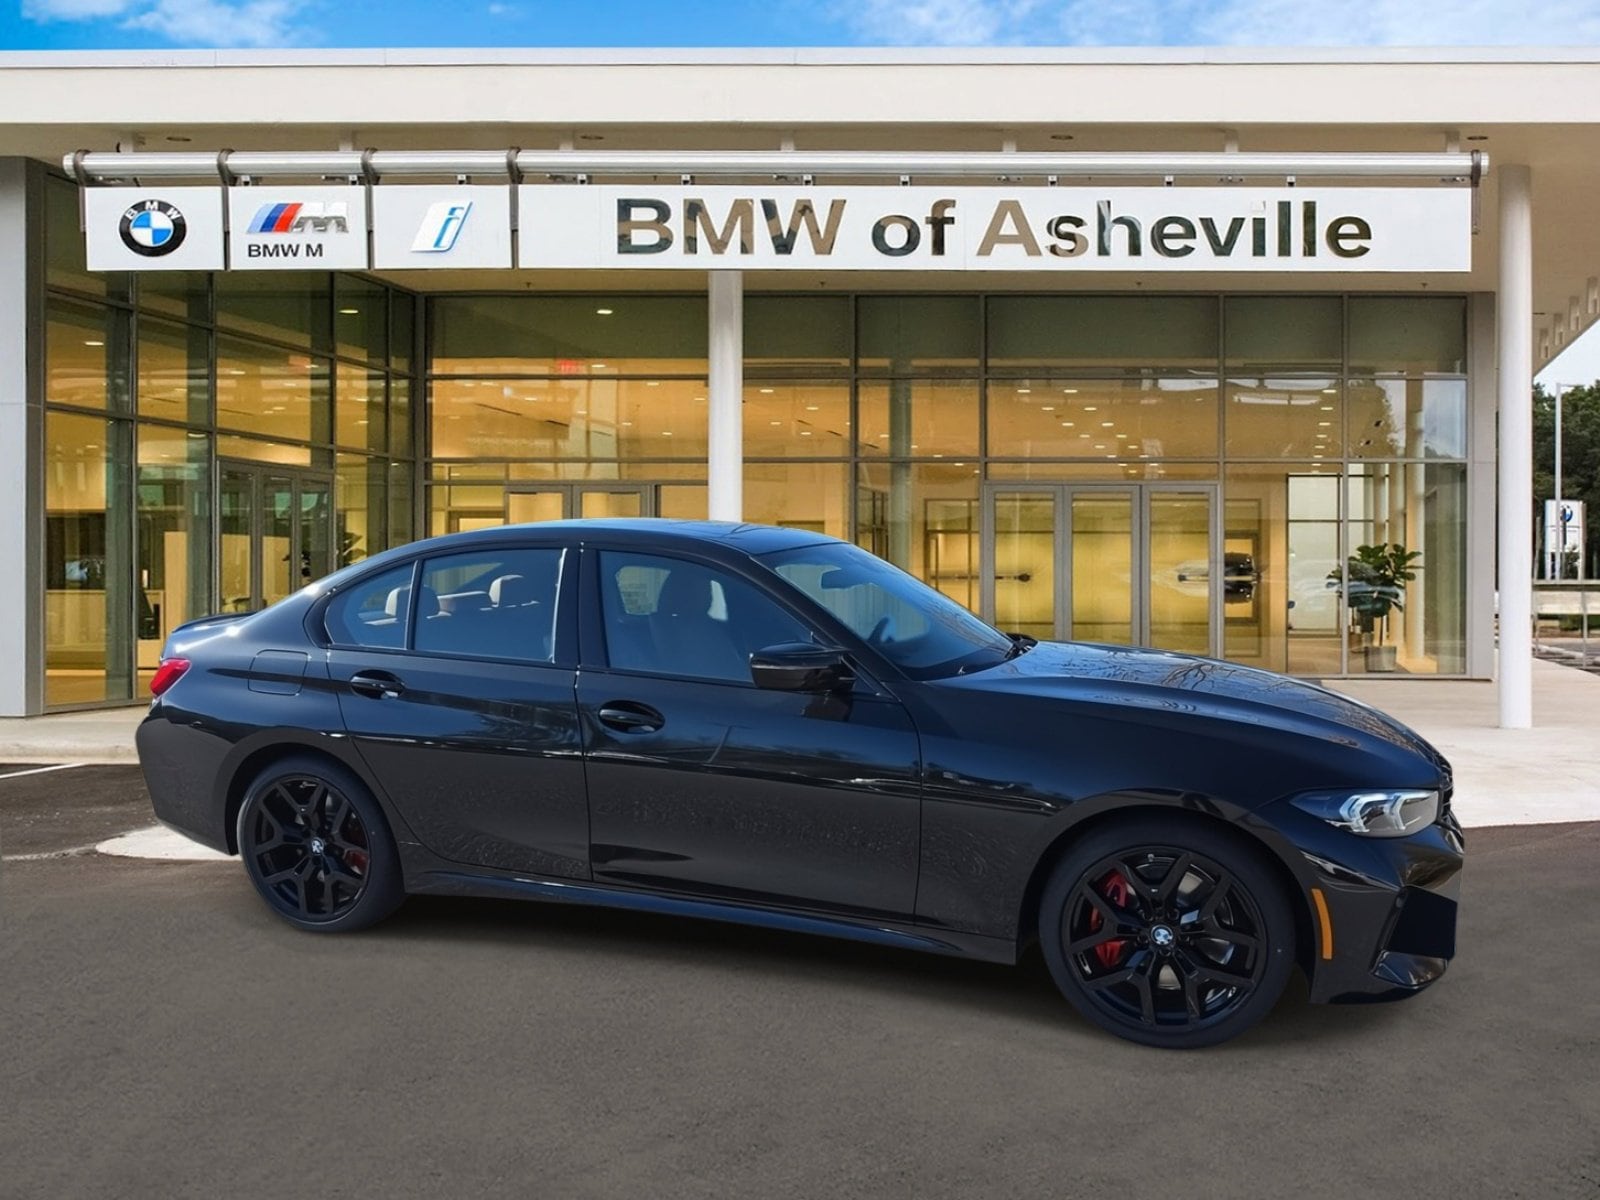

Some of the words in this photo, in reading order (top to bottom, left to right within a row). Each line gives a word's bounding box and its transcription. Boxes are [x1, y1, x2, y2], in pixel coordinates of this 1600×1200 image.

[124, 200, 184, 222] BMW
[616, 198, 847, 255] BMW
[871, 199, 956, 257] of
[975, 199, 1372, 258] Asheville
[247, 243, 300, 258] BMW
[304, 243, 324, 258] M
